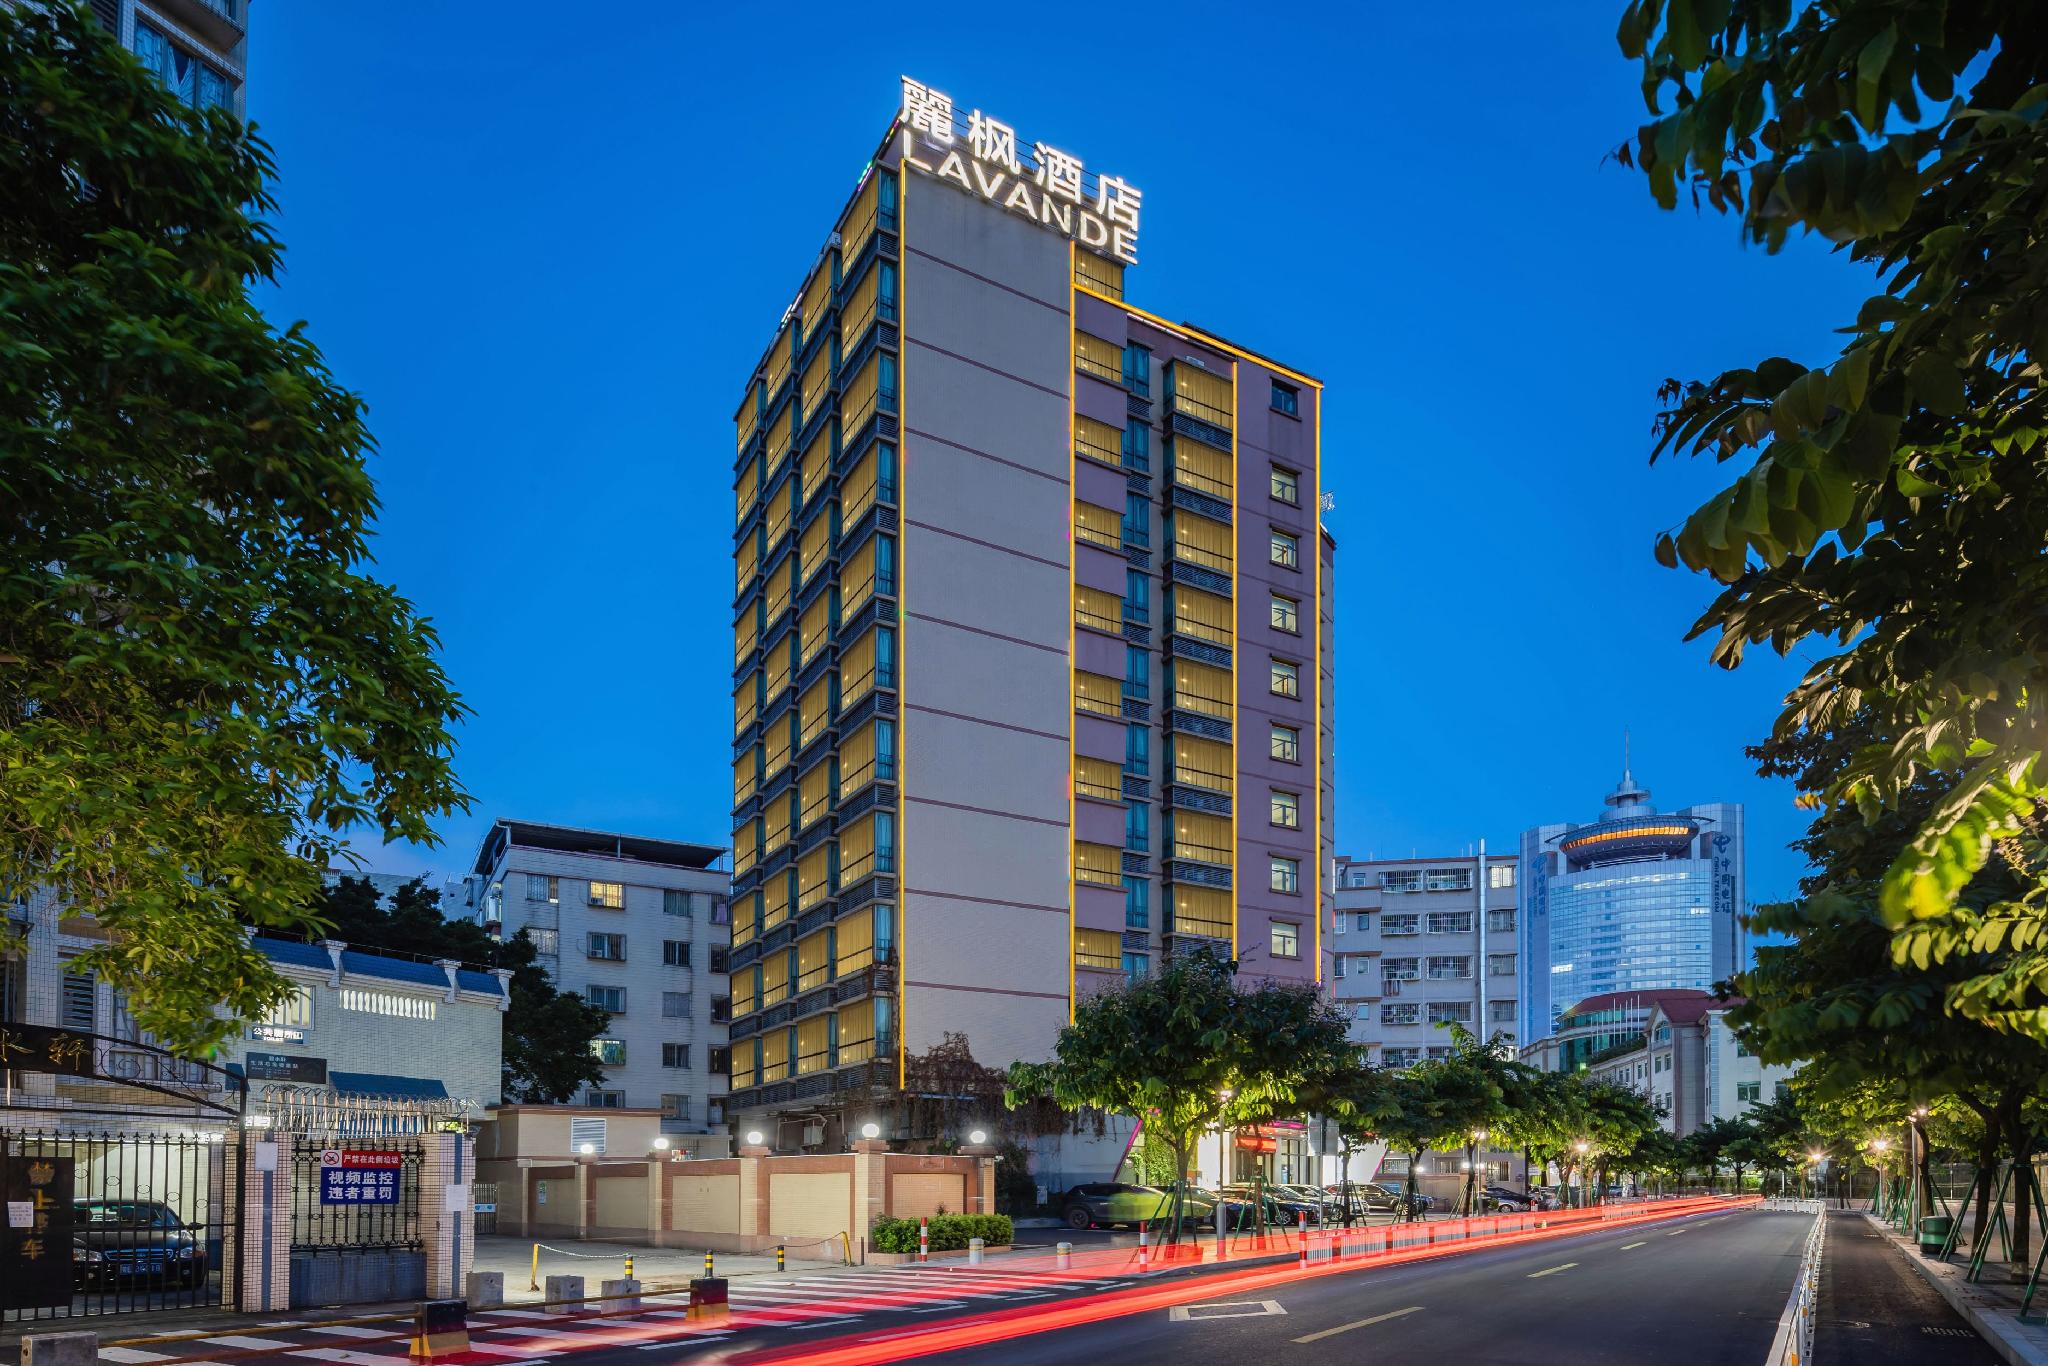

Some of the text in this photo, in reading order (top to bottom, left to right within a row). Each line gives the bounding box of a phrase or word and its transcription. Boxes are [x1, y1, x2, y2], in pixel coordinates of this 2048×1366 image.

[903, 129, 1138, 265] LAVANDE
[1720, 857, 1731, 914] 中国电信
[343, 1154, 399, 1164] 严禁在此倒垃圾
[328, 1171, 394, 1185] 视频监控
[328, 1186, 393, 1200] 违者重罚
